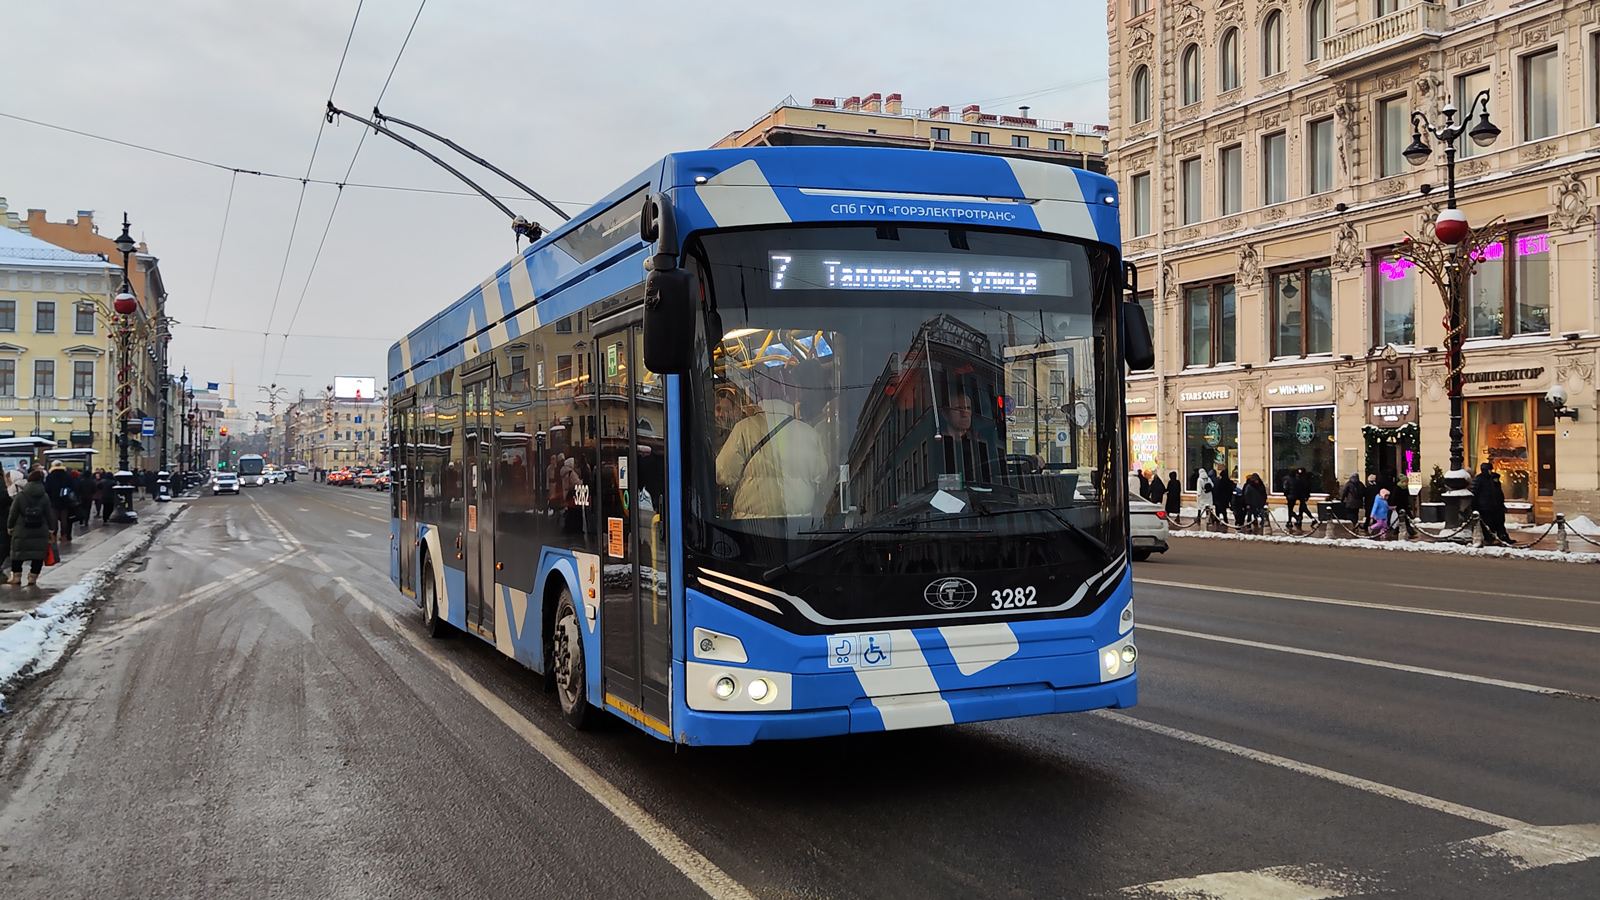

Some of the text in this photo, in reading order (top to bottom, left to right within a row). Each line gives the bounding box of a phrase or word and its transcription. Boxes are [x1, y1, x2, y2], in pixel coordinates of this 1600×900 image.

[860, 204, 886, 215] ГУП
[888, 205, 1016, 222] «ГОРЭЛЕКТРОТРАНС»
[771, 255, 1038, 294] 7 Таллинская улица
[1180, 390, 1229, 401] STARS COFFEE
[1373, 405, 1410, 416] KEMPF
[574, 484, 590, 506] 3282
[990, 585, 1038, 610] 3282
